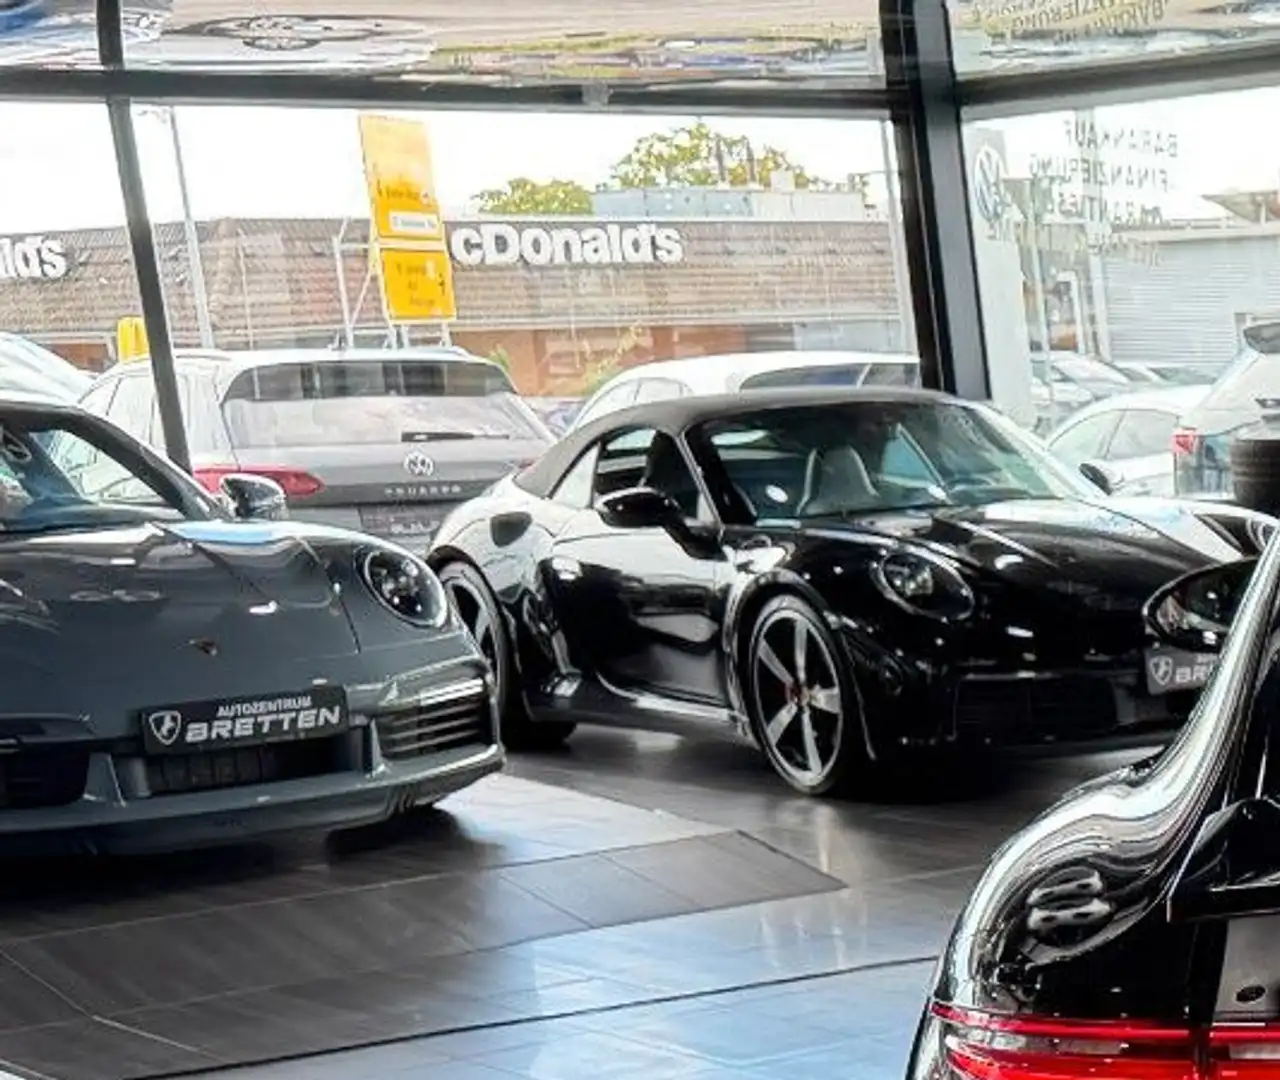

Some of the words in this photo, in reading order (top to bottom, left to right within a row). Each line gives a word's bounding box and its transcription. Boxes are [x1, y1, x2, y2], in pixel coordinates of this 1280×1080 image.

[452, 223, 684, 266] cDonald's
[184, 705, 342, 745] BRETTEN
[216, 695, 314, 718] AUTOZENTRUM
